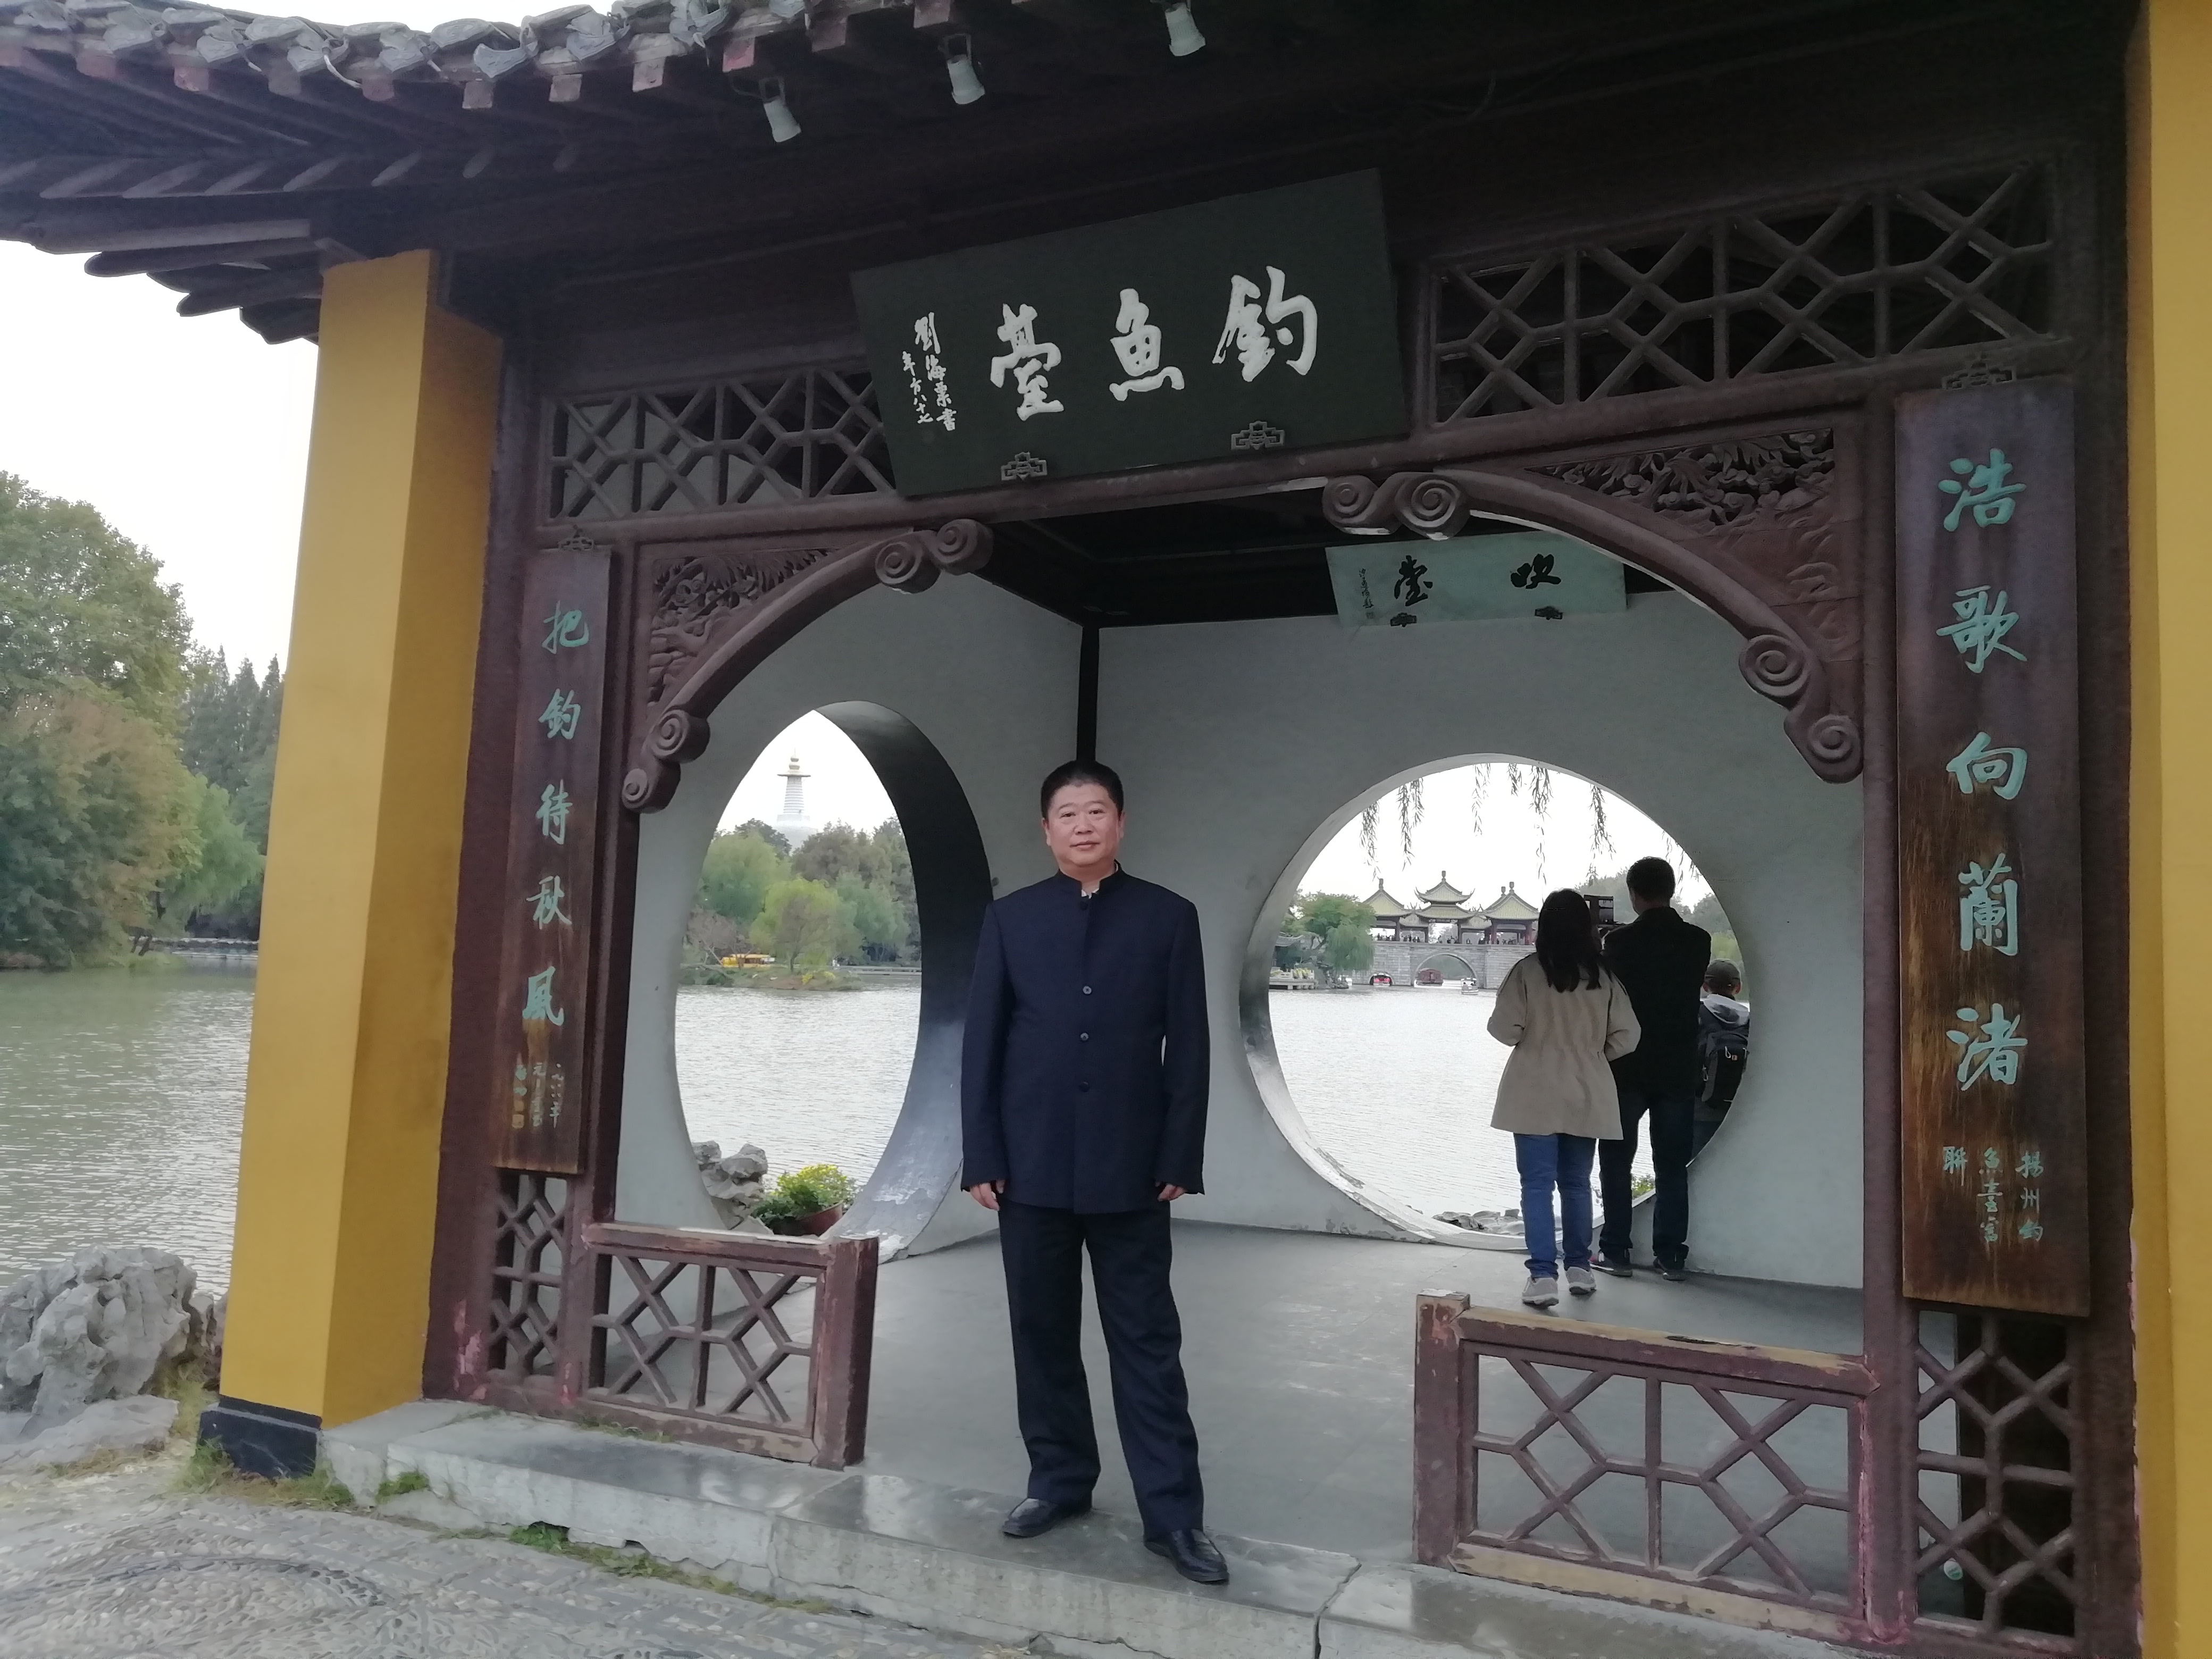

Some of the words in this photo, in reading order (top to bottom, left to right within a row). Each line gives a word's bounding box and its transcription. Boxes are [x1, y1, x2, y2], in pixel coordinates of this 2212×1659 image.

[1936, 447, 2027, 1091] 浩歌向蘭渚
